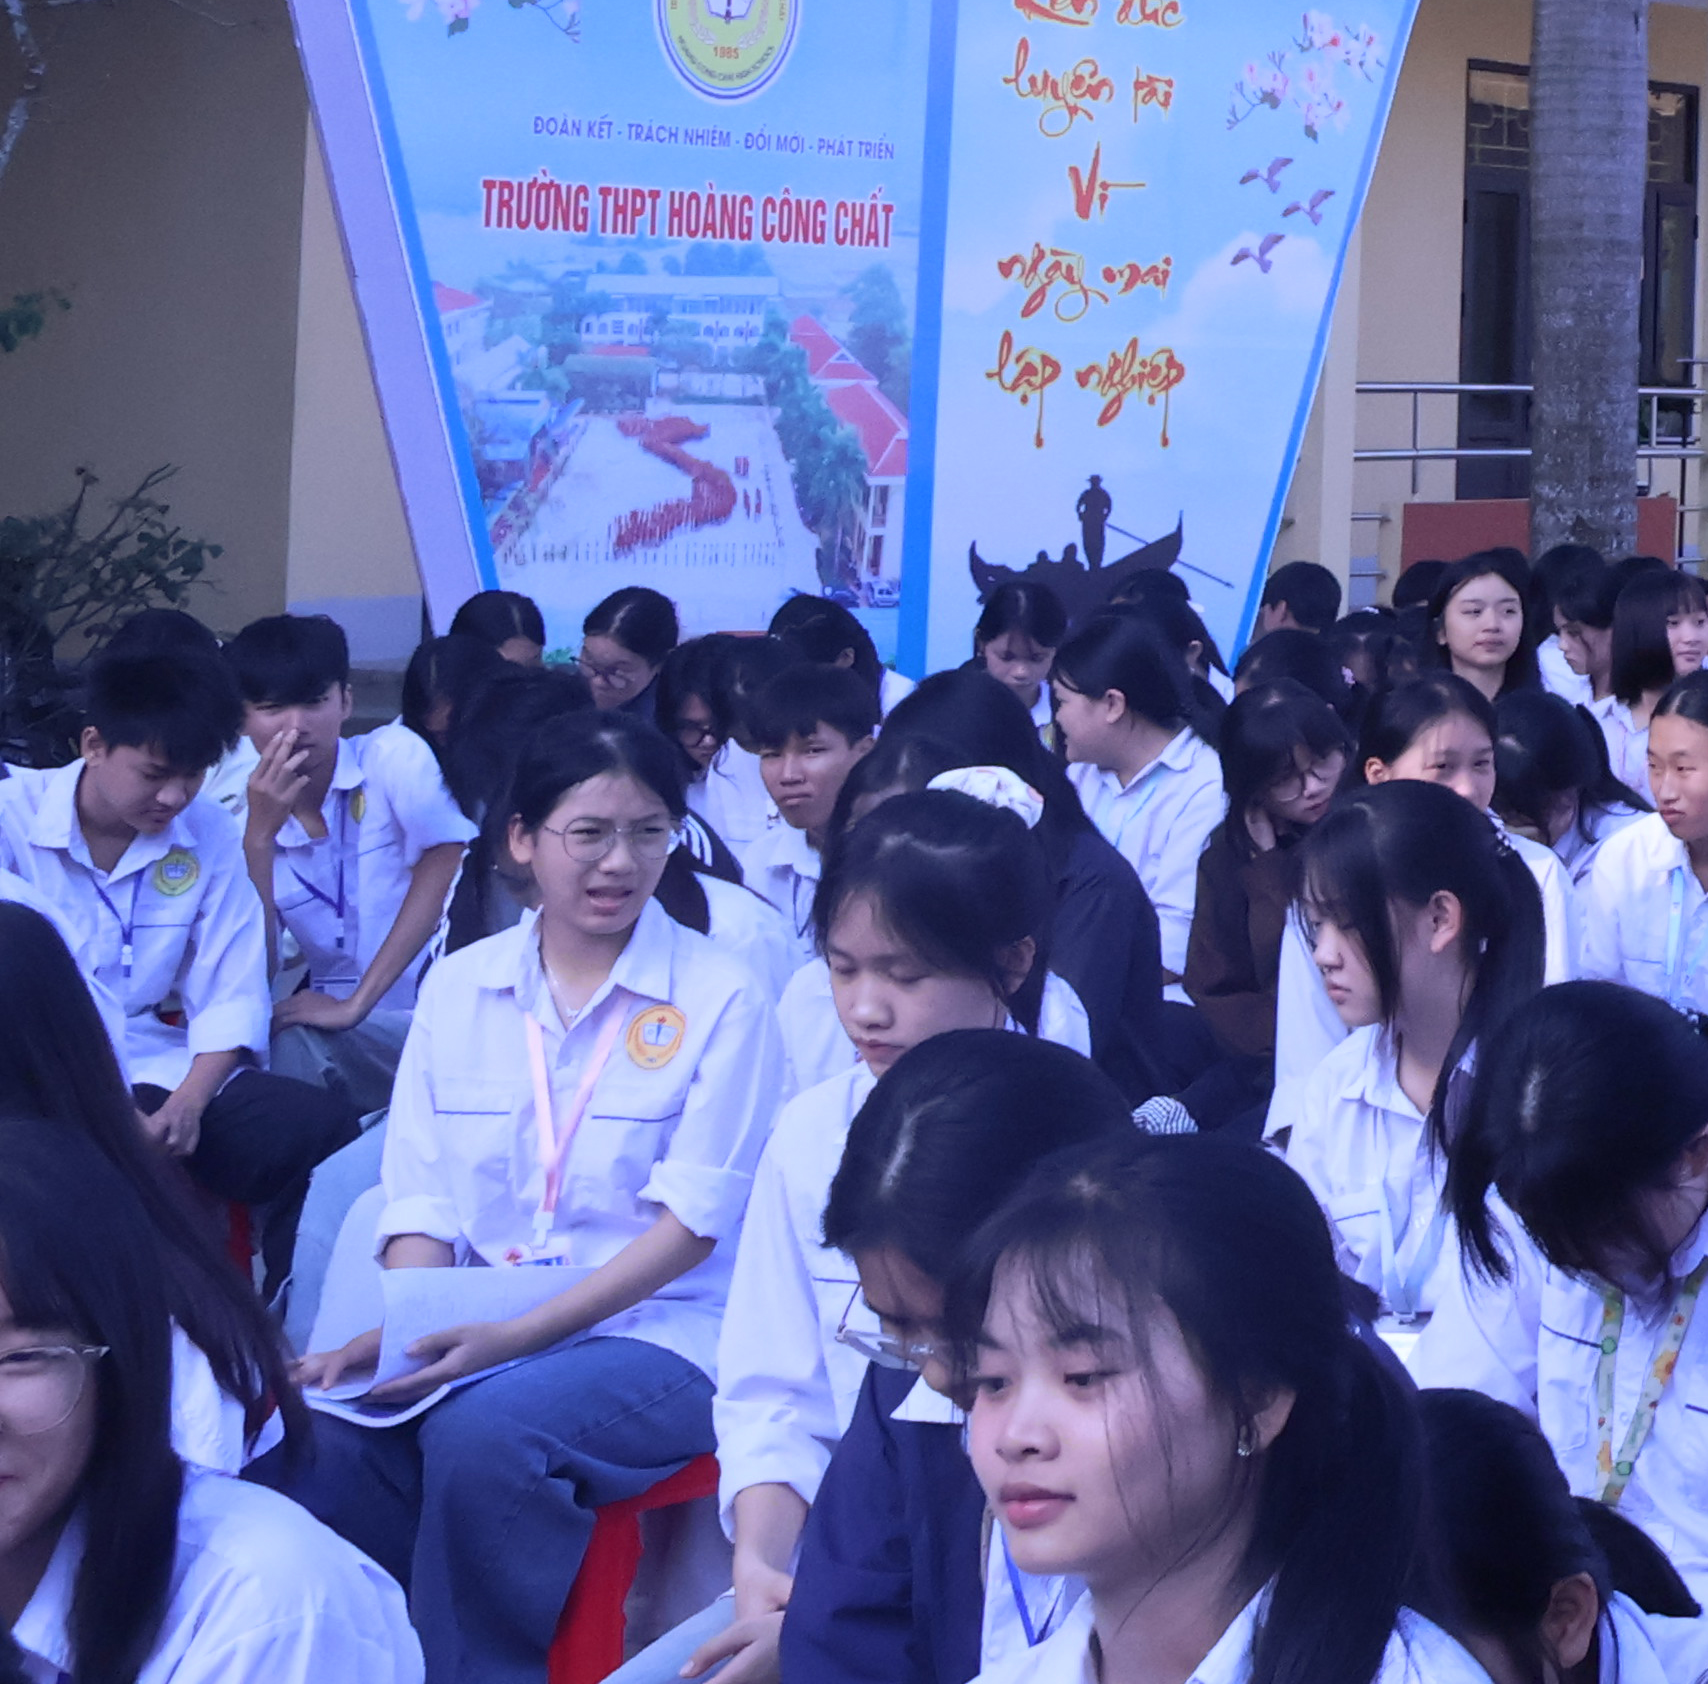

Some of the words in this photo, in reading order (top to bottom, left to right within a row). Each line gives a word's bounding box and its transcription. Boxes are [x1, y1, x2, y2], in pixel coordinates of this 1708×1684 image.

[533, 113, 581, 137] ĐOÀN
[587, 113, 613, 140] KẾT
[627, 119, 679, 144] TRÁCH
[744, 123, 771, 151] ĐỔI
[817, 133, 853, 157] PHÁT
[858, 132, 894, 160] TRIỂN
[482, 169, 589, 233] TRƯỜNG
[599, 186, 661, 236] THPT
[668, 182, 753, 241] HOÀNG
[761, 185, 827, 244] CÔNG
[834, 184, 894, 247] CHẤT
